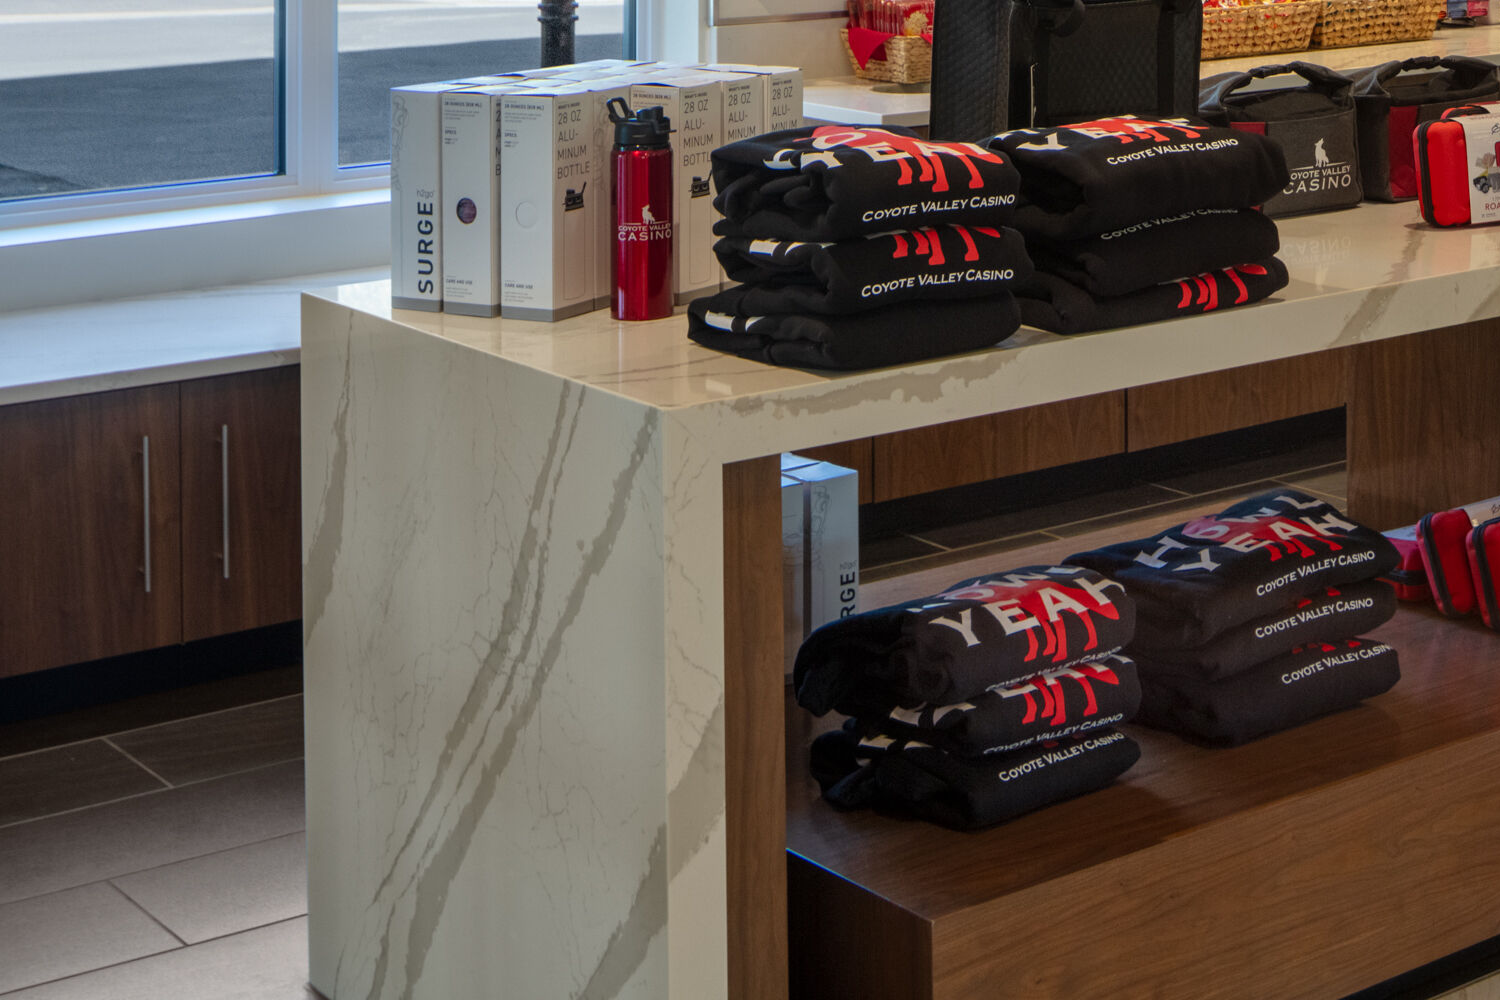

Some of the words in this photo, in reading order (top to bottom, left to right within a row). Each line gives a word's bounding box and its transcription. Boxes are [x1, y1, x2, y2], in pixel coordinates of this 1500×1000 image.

[728, 94, 738, 106] 28
[740, 92, 751, 104] OZ
[772, 88, 782, 100] 28
[783, 86, 793, 98] OZ
[684, 101, 695, 113] 28
[698, 99, 708, 111] OZ
[772, 105, 790, 116] ALU-
[558, 112, 568, 124] 28
[570, 110, 581, 122] OZ
[684, 119, 704, 130] ALU-
[728, 112, 748, 122] ALU-
[557, 130, 578, 142] ALU-
[683, 134, 713, 148] MINUM
[728, 126, 756, 140] MINUM
[557, 145, 587, 161] MINUM
[683, 152, 711, 167] BOTTL
[1106, 149, 1153, 166] COYOTE
[1154, 143, 1195, 156] VALLEY
[1195, 138, 1239, 152] CASINO
[557, 161, 590, 179] BOTTLE
[1290, 170, 1320, 181] OYOTE
[1322, 165, 1352, 177] VALLEY
[1282, 174, 1352, 195] CASINO
[862, 203, 917, 222] COYOTE
[920, 199, 968, 213] VALLEY
[969, 194, 1015, 208] CASINO
[648, 223, 672, 231] VALLEY
[1100, 221, 1151, 240] COYOTE
[1152, 211, 1195, 226] VALLEY
[618, 229, 672, 241] CASINO
[416, 201, 434, 294] SURGE
[861, 277, 915, 298] COYOTE
[918, 272, 964, 286] VALLEY
[965, 269, 1014, 281] CASINO
[1133, 495, 1326, 569] HOWL
[1172, 512, 1359, 573] YEAH
[1256, 571, 1297, 597] COYOTE
[1297, 556, 1337, 579] VALLEY
[1338, 550, 1376, 567] CASINO
[840, 571, 856, 619] RGE
[928, 576, 1127, 647] YEAH
[1255, 614, 1298, 640] COYOTE
[1297, 604, 1336, 624] VALLEY
[1336, 597, 1374, 614] CASINO
[1281, 661, 1325, 685] COYOTE
[1322, 652, 1360, 669] VALLEY
[1359, 643, 1391, 660] CASIN
[983, 735, 1034, 755] COYOTE
[1036, 722, 1078, 742] VALLEY
[1079, 712, 1123, 731] CASINO
[998, 758, 1045, 782] COYOTE
[1045, 745, 1084, 765] VALLEY
[1084, 732, 1124, 751] CASINO
